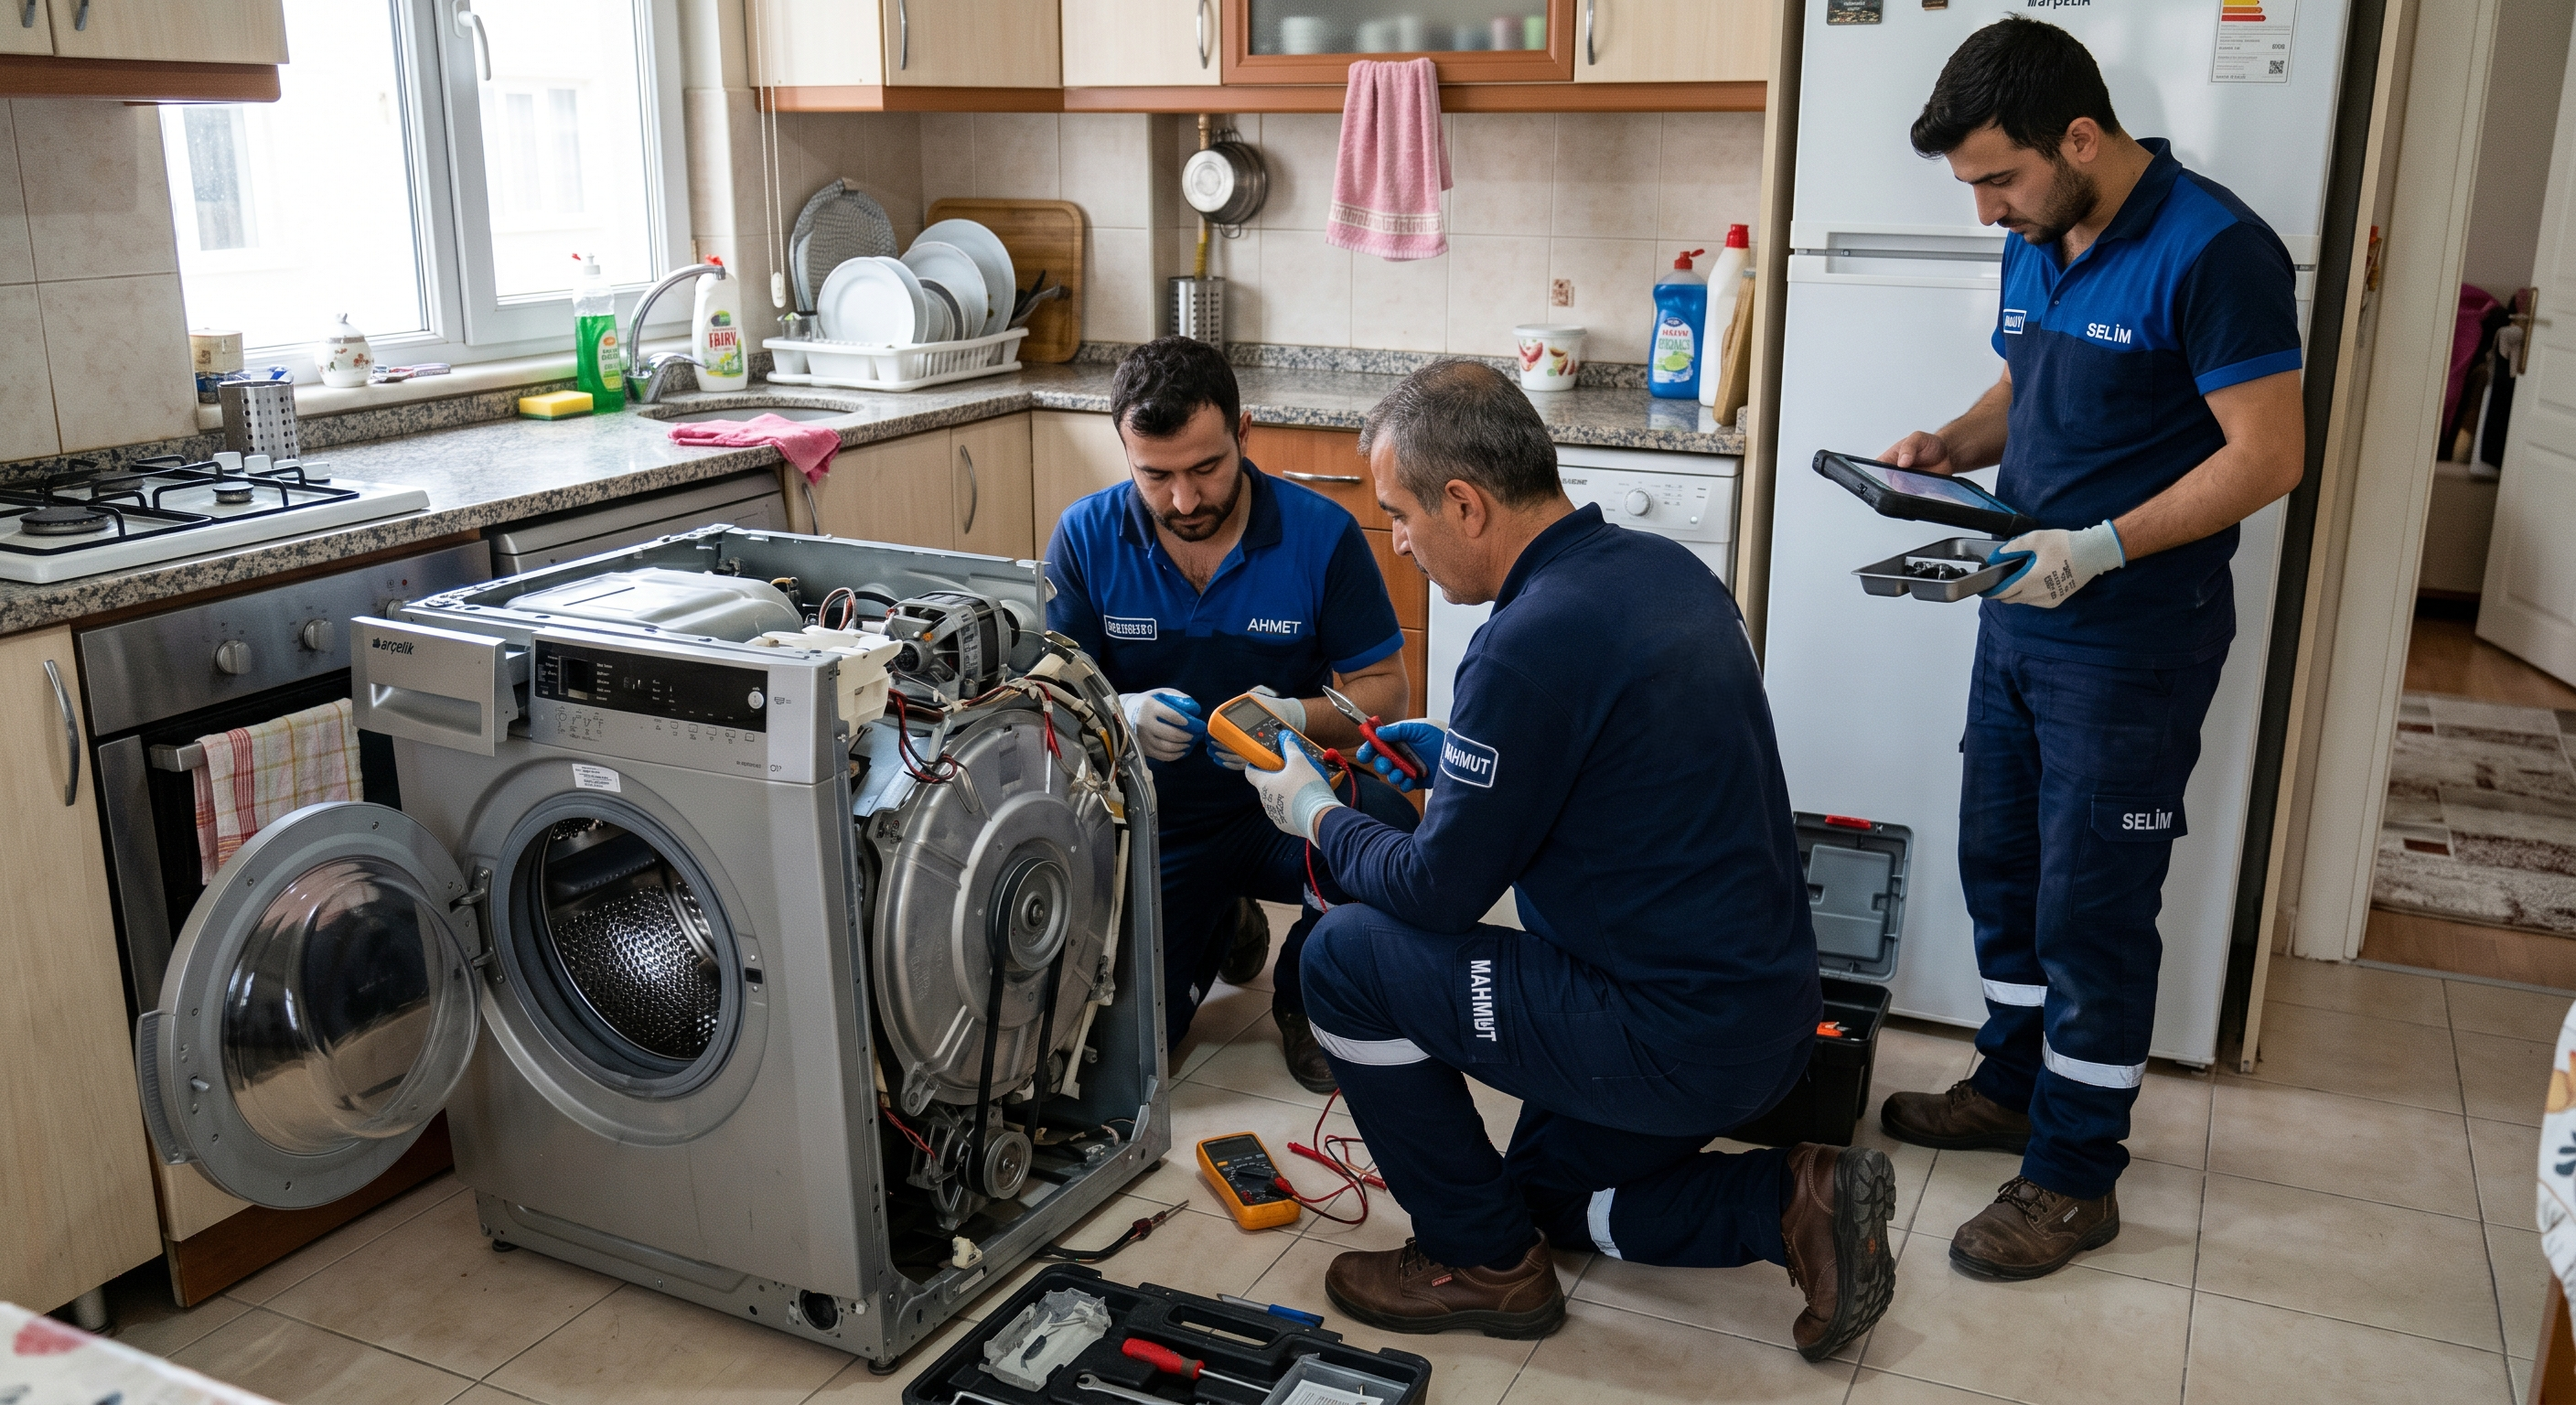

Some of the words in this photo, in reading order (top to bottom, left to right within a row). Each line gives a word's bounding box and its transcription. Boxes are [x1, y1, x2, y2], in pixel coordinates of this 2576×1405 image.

[2087, 324, 2132, 344] SELİM
[1247, 617, 1302, 635] AHMET
[381, 639, 414, 655] arçelik
[2121, 809, 2174, 831] SELİM
[1470, 960, 1497, 1042] MAHMUT
